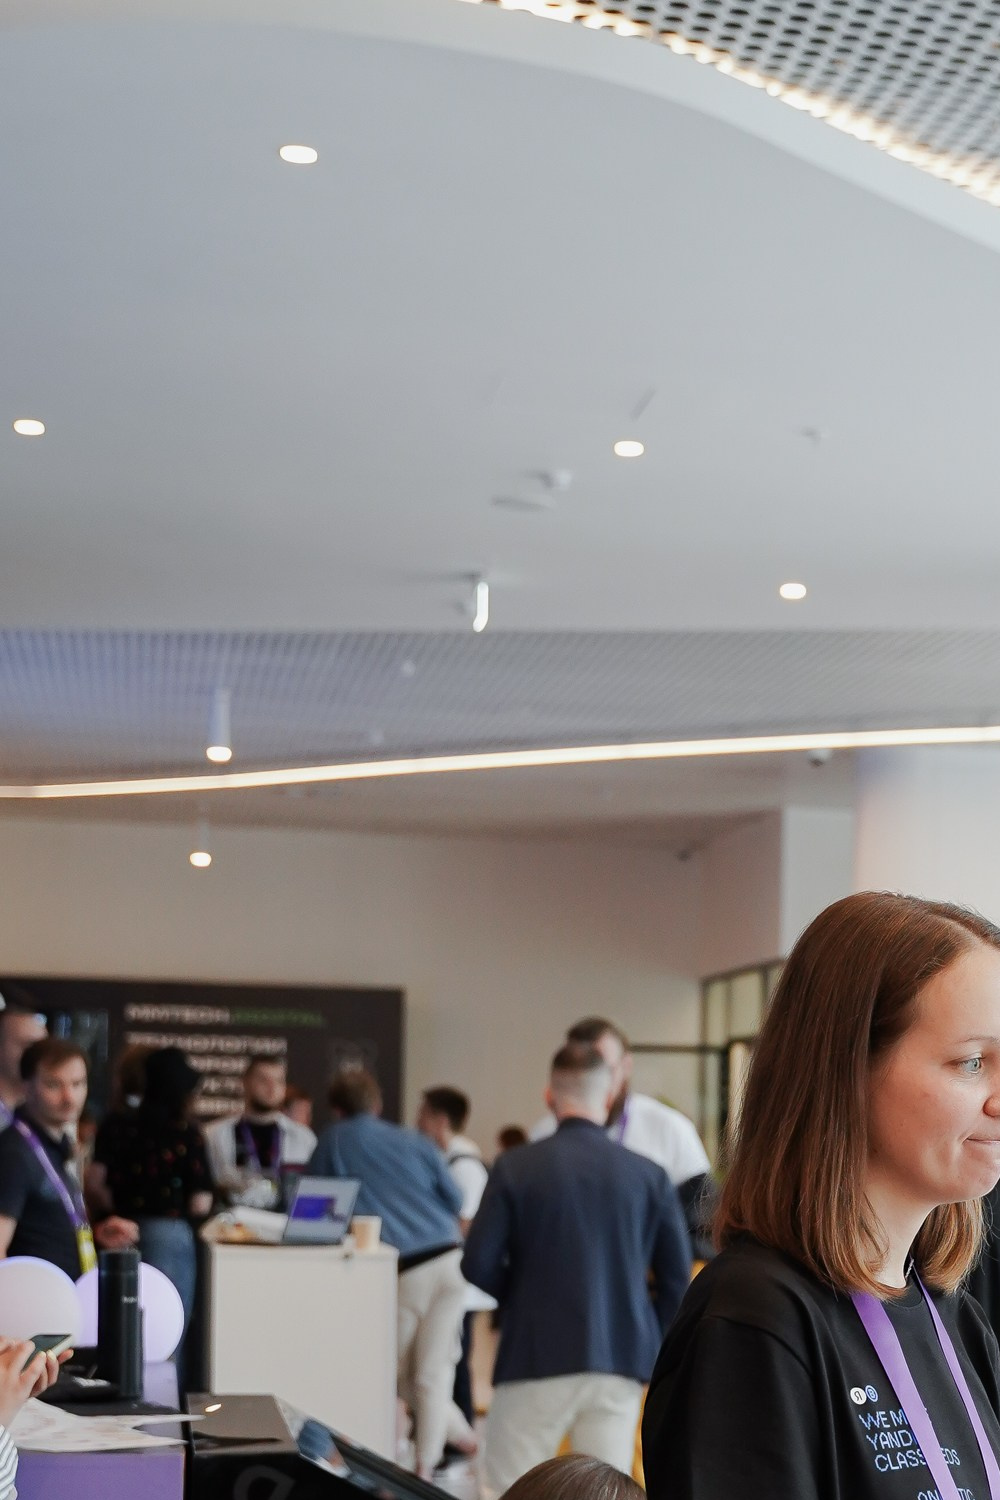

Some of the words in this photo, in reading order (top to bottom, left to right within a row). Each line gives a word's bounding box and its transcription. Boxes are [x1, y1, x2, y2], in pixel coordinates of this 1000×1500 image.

[858, 1411, 890, 1430] WE
[866, 1430, 917, 1450] YAND
[875, 1448, 960, 1471] CLASSEDS
